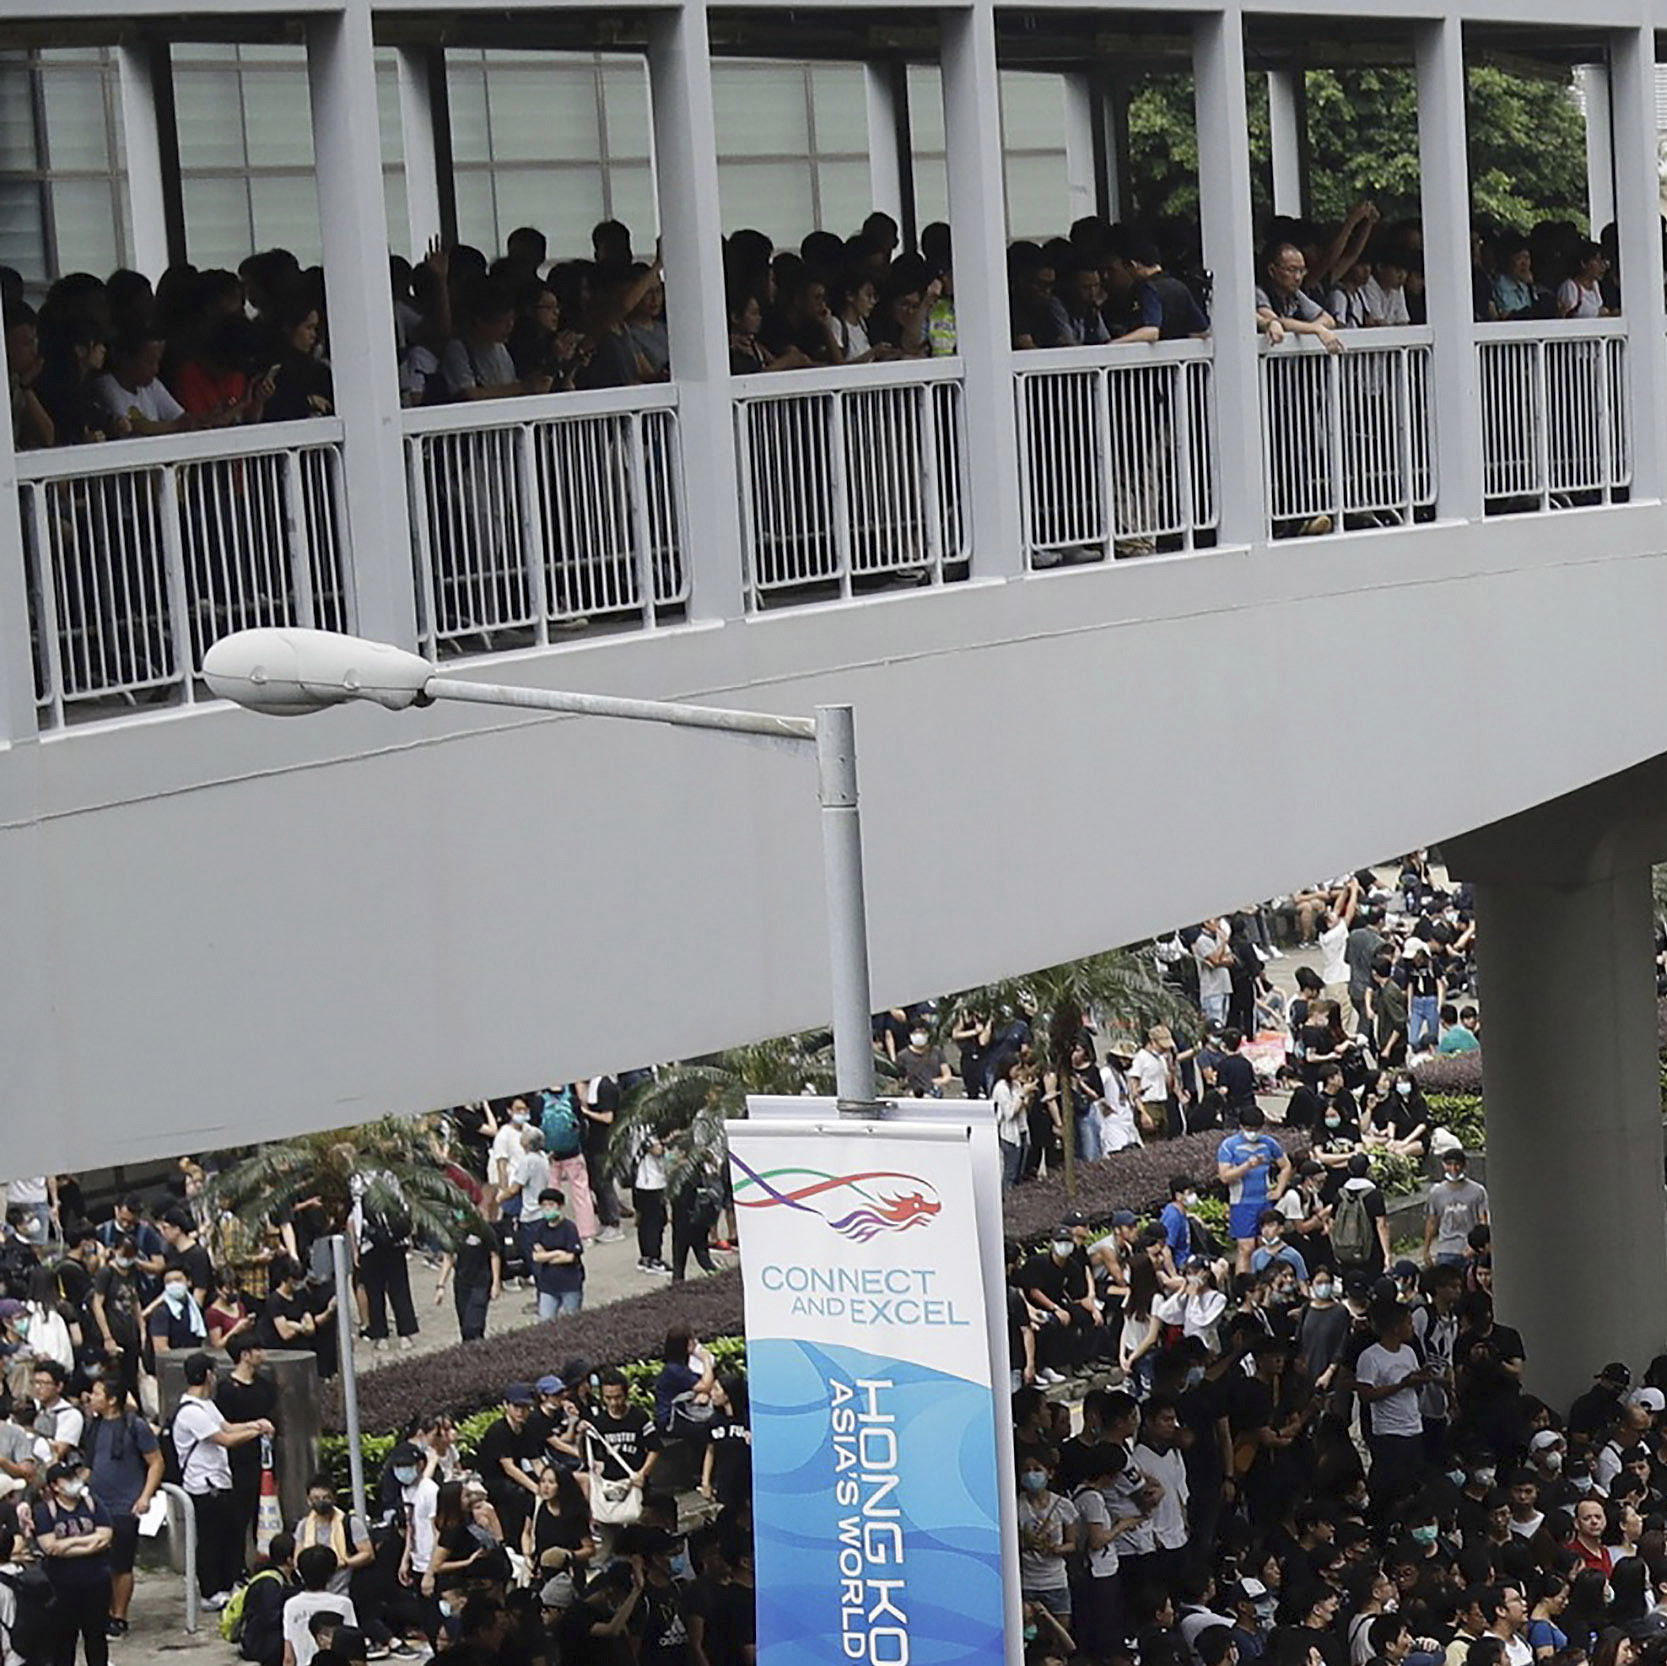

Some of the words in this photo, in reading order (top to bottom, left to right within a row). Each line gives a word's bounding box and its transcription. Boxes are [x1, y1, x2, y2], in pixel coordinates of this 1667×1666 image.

[762, 1265, 937, 1295] CONNECT
[791, 1296, 847, 1318] AND
[850, 1299, 970, 1327] EXCEL
[829, 1379, 860, 1507] ASIA'S
[856, 1378, 905, 1565] HONG
[838, 1517, 868, 1660] WORLD
